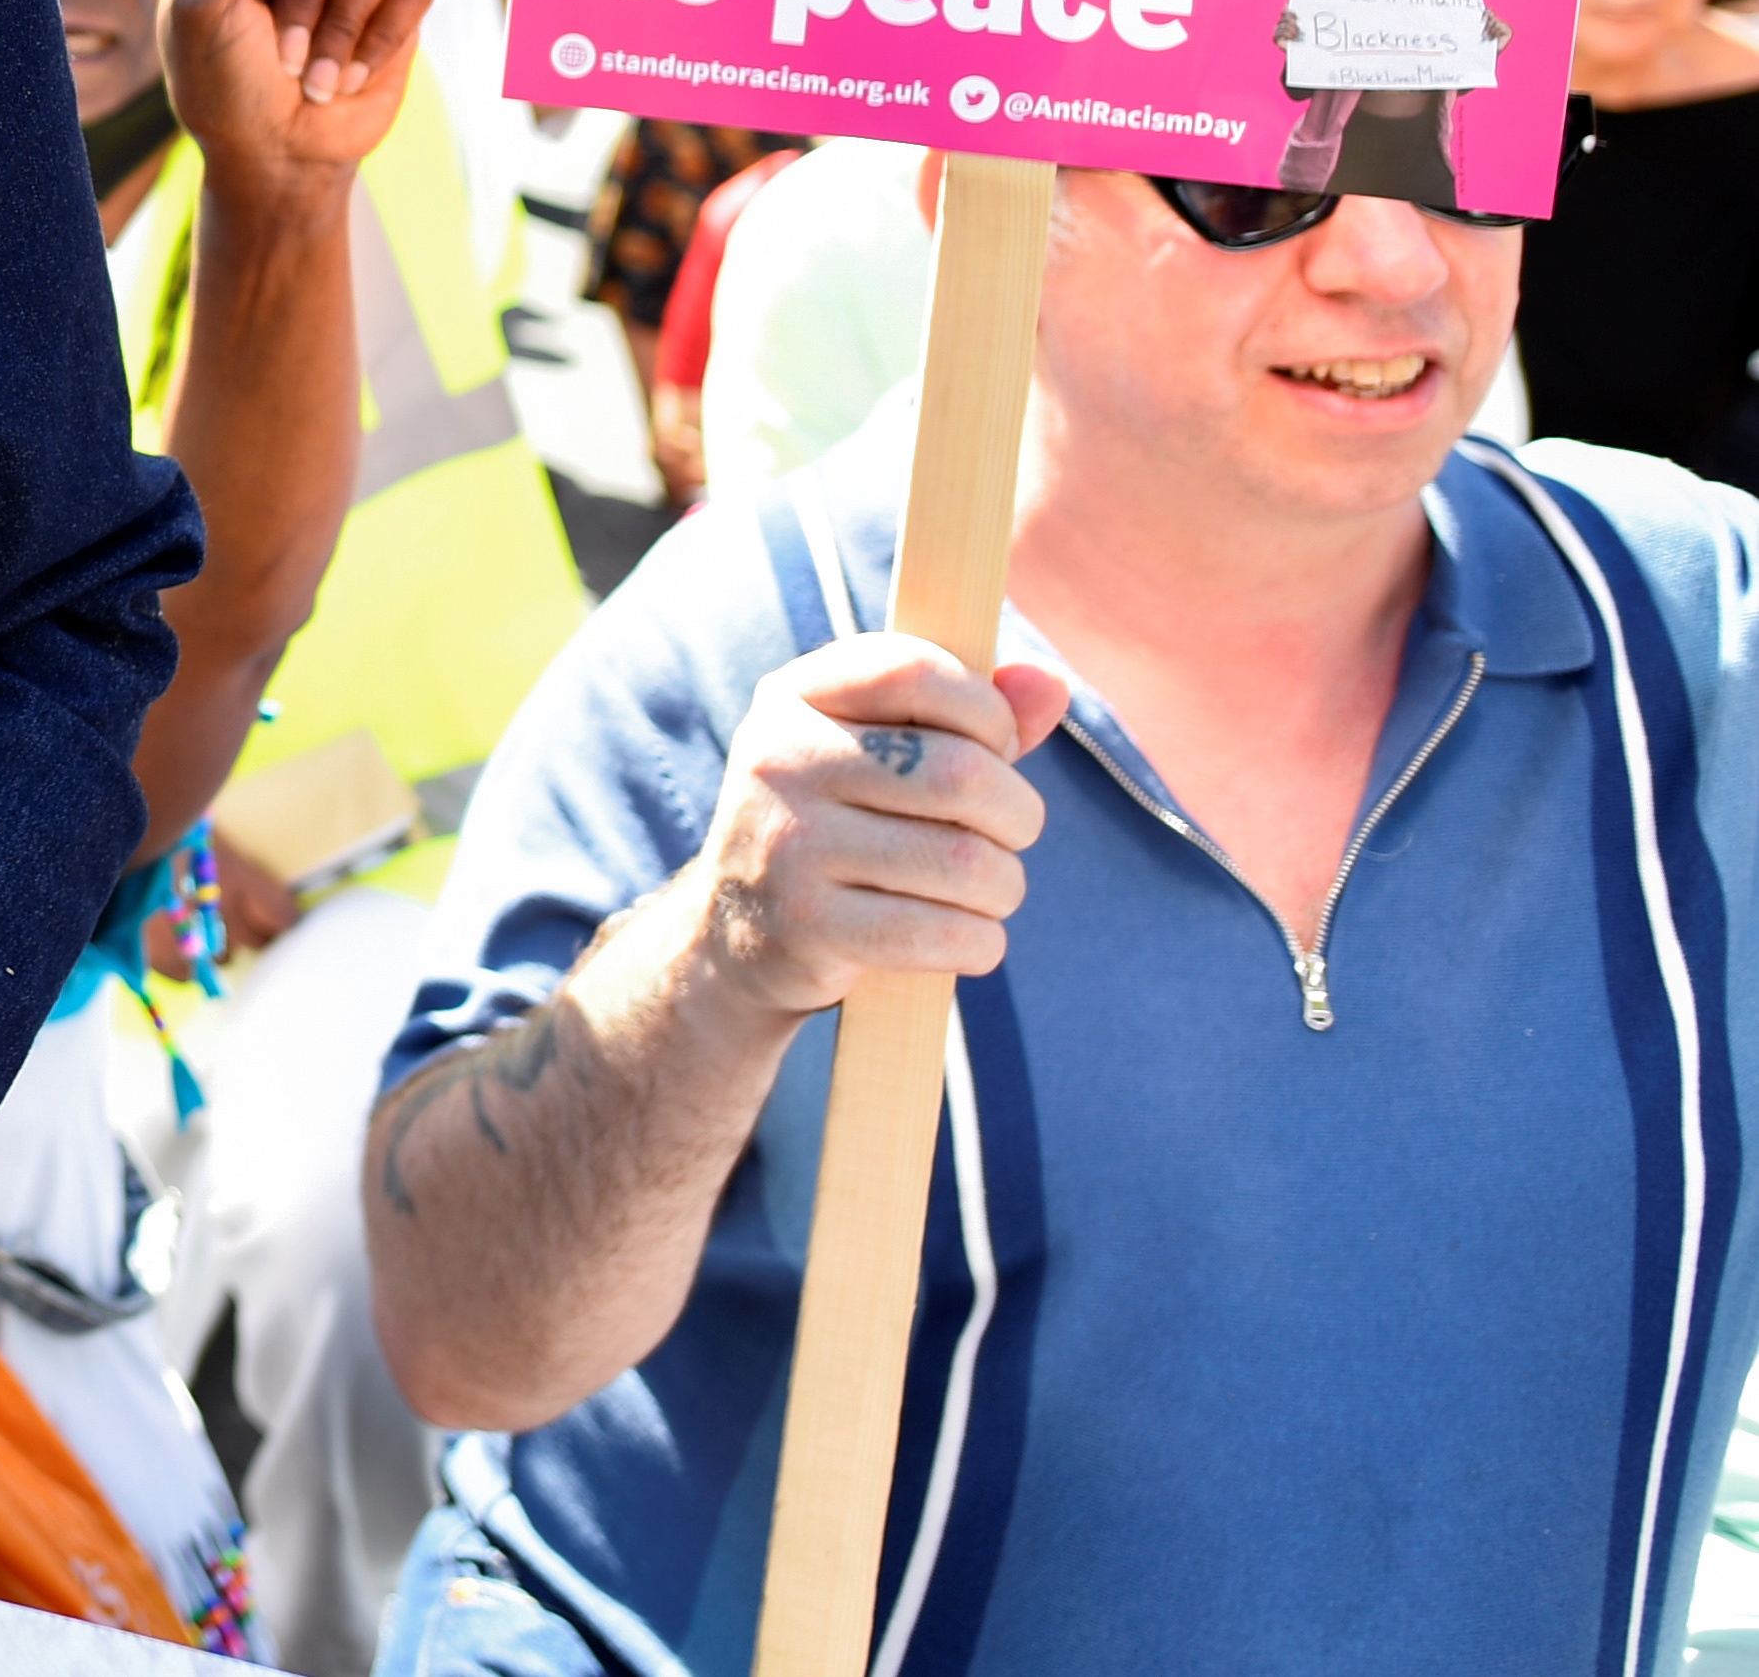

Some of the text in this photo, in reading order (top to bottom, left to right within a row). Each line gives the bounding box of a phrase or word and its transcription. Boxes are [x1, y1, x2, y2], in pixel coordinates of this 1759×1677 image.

[1313, 10, 1459, 54] Blackness
[600, 48, 1247, 145] standuptoracism.org.uk @AntiRacismDay
